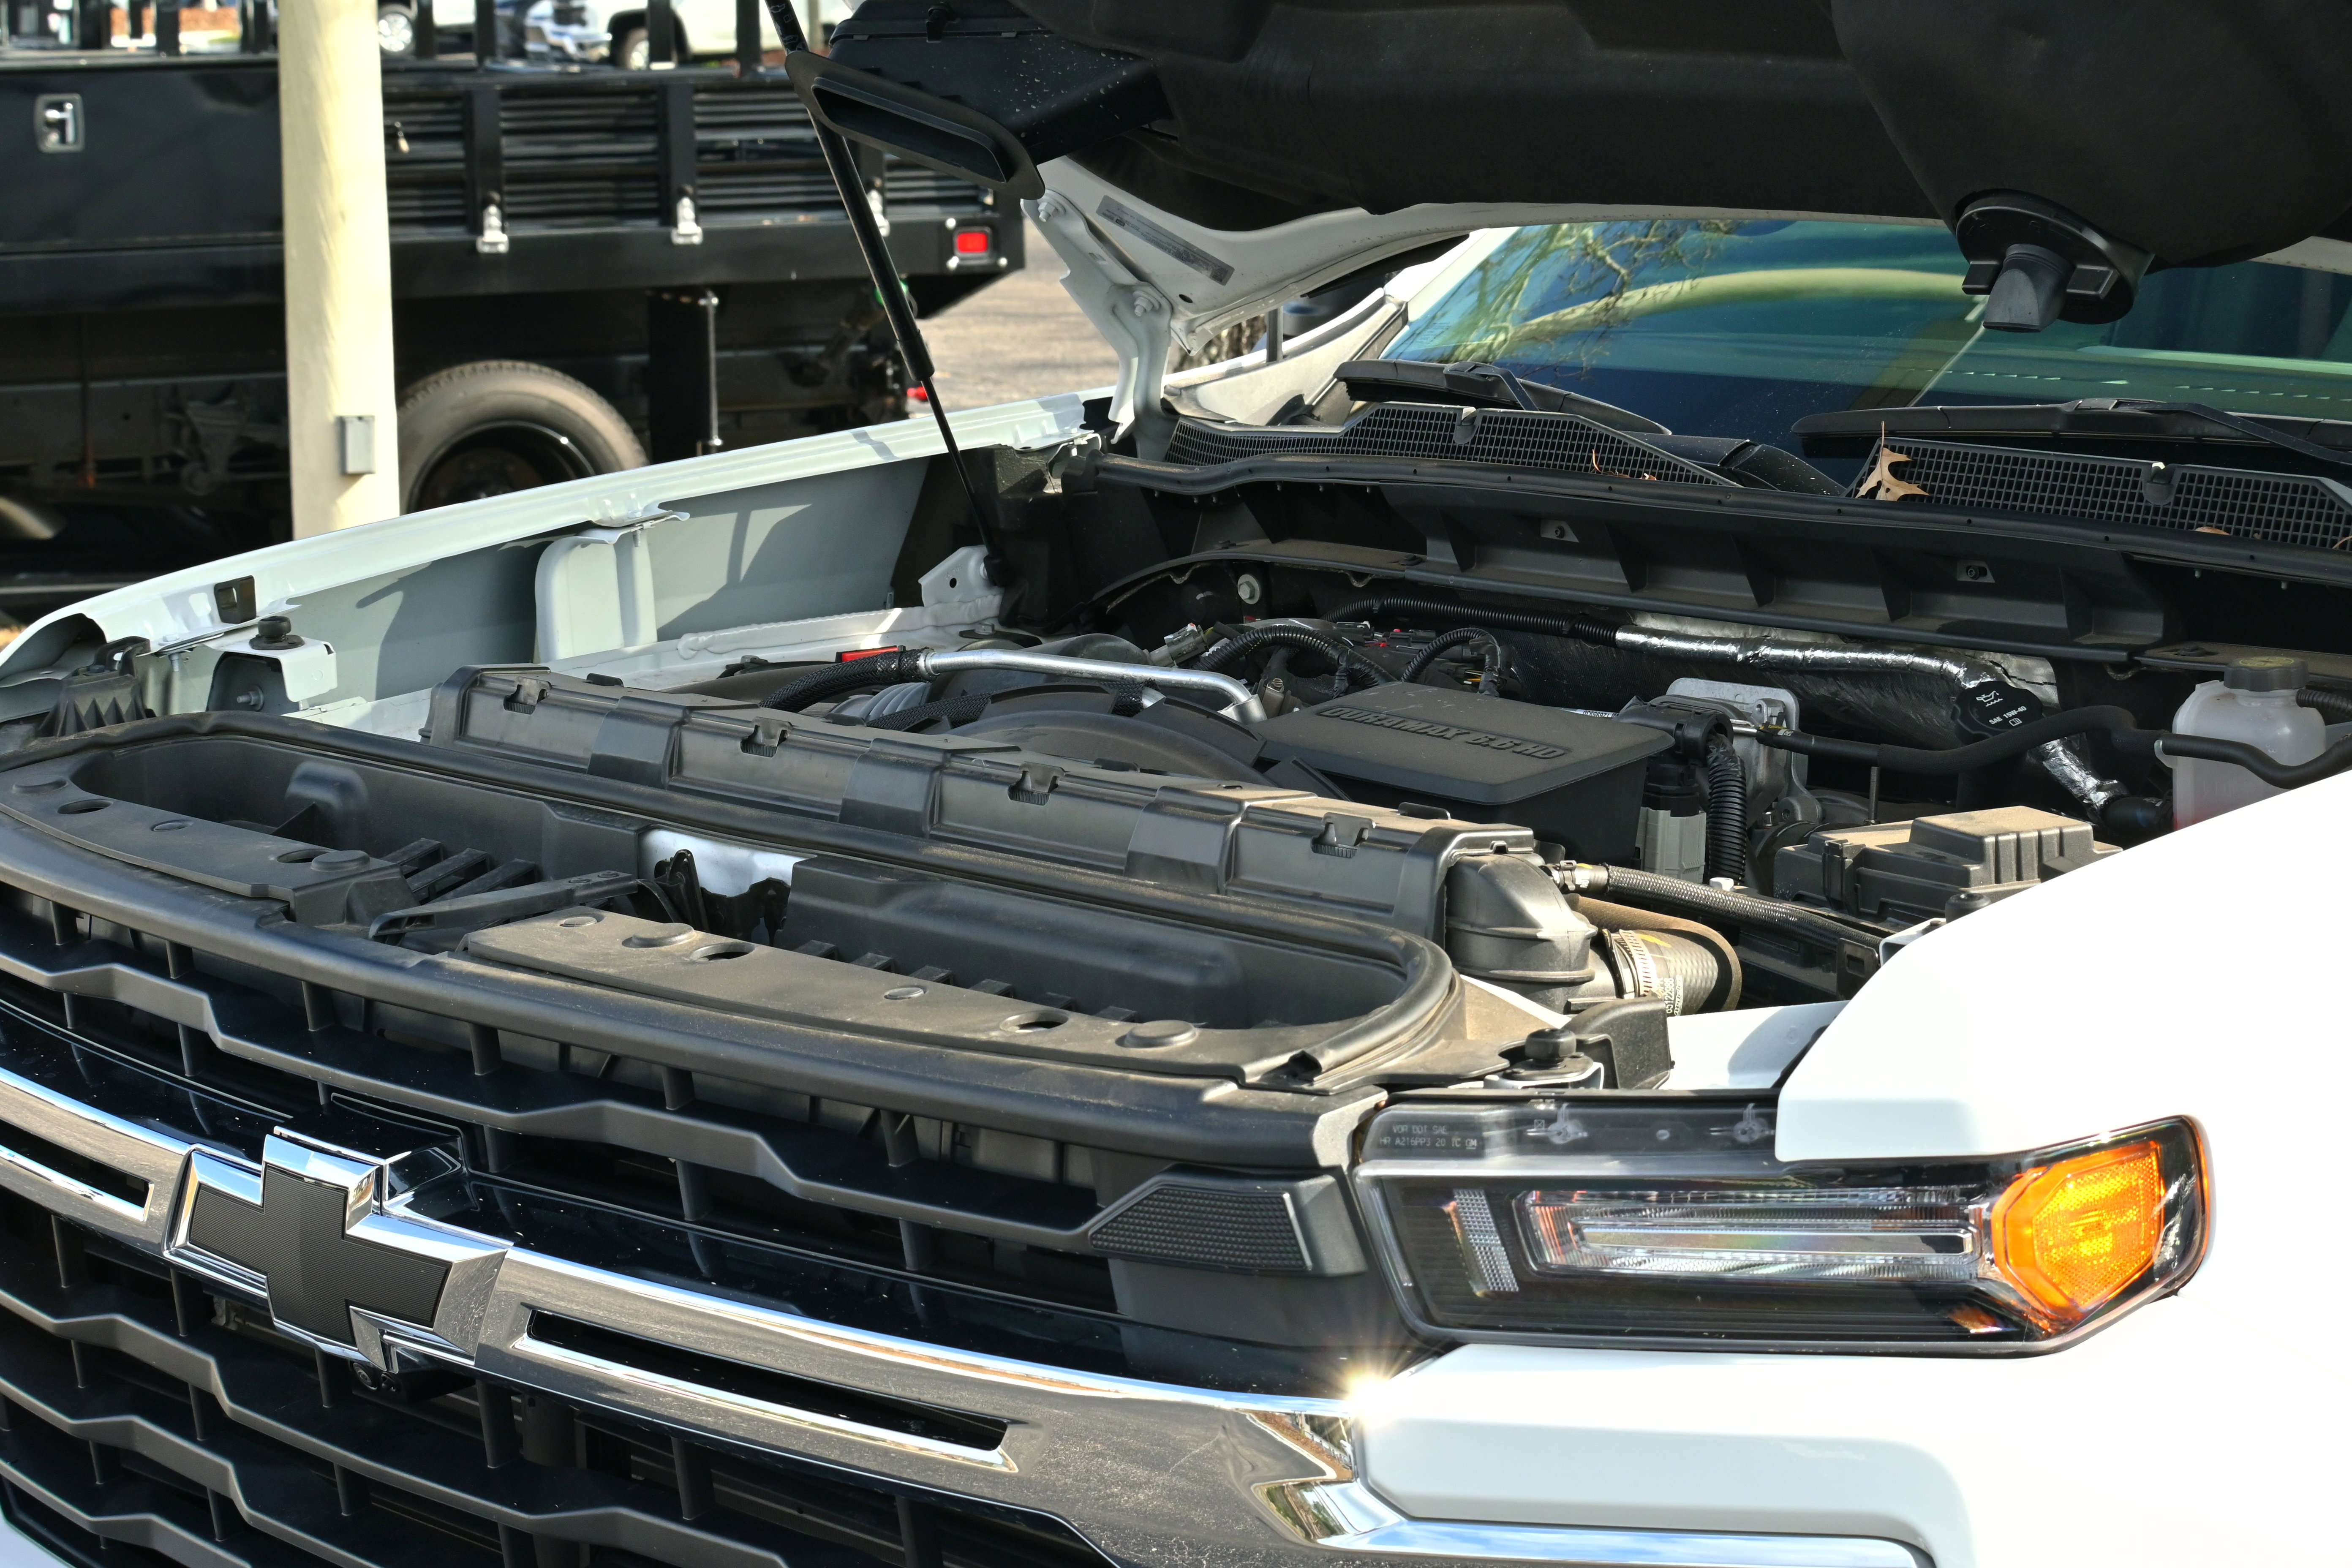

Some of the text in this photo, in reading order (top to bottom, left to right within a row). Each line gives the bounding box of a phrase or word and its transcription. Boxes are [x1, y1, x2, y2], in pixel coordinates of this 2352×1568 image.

[1989, 706, 2027, 724] SAE 15W-40
[1319, 707, 1565, 760] DURAMAX 6.6 HD
[1393, 1124, 1448, 1135] VOR DOT SAE
[1435, 1138, 1446, 1146] 20
[1465, 1138, 1477, 1149] GM
